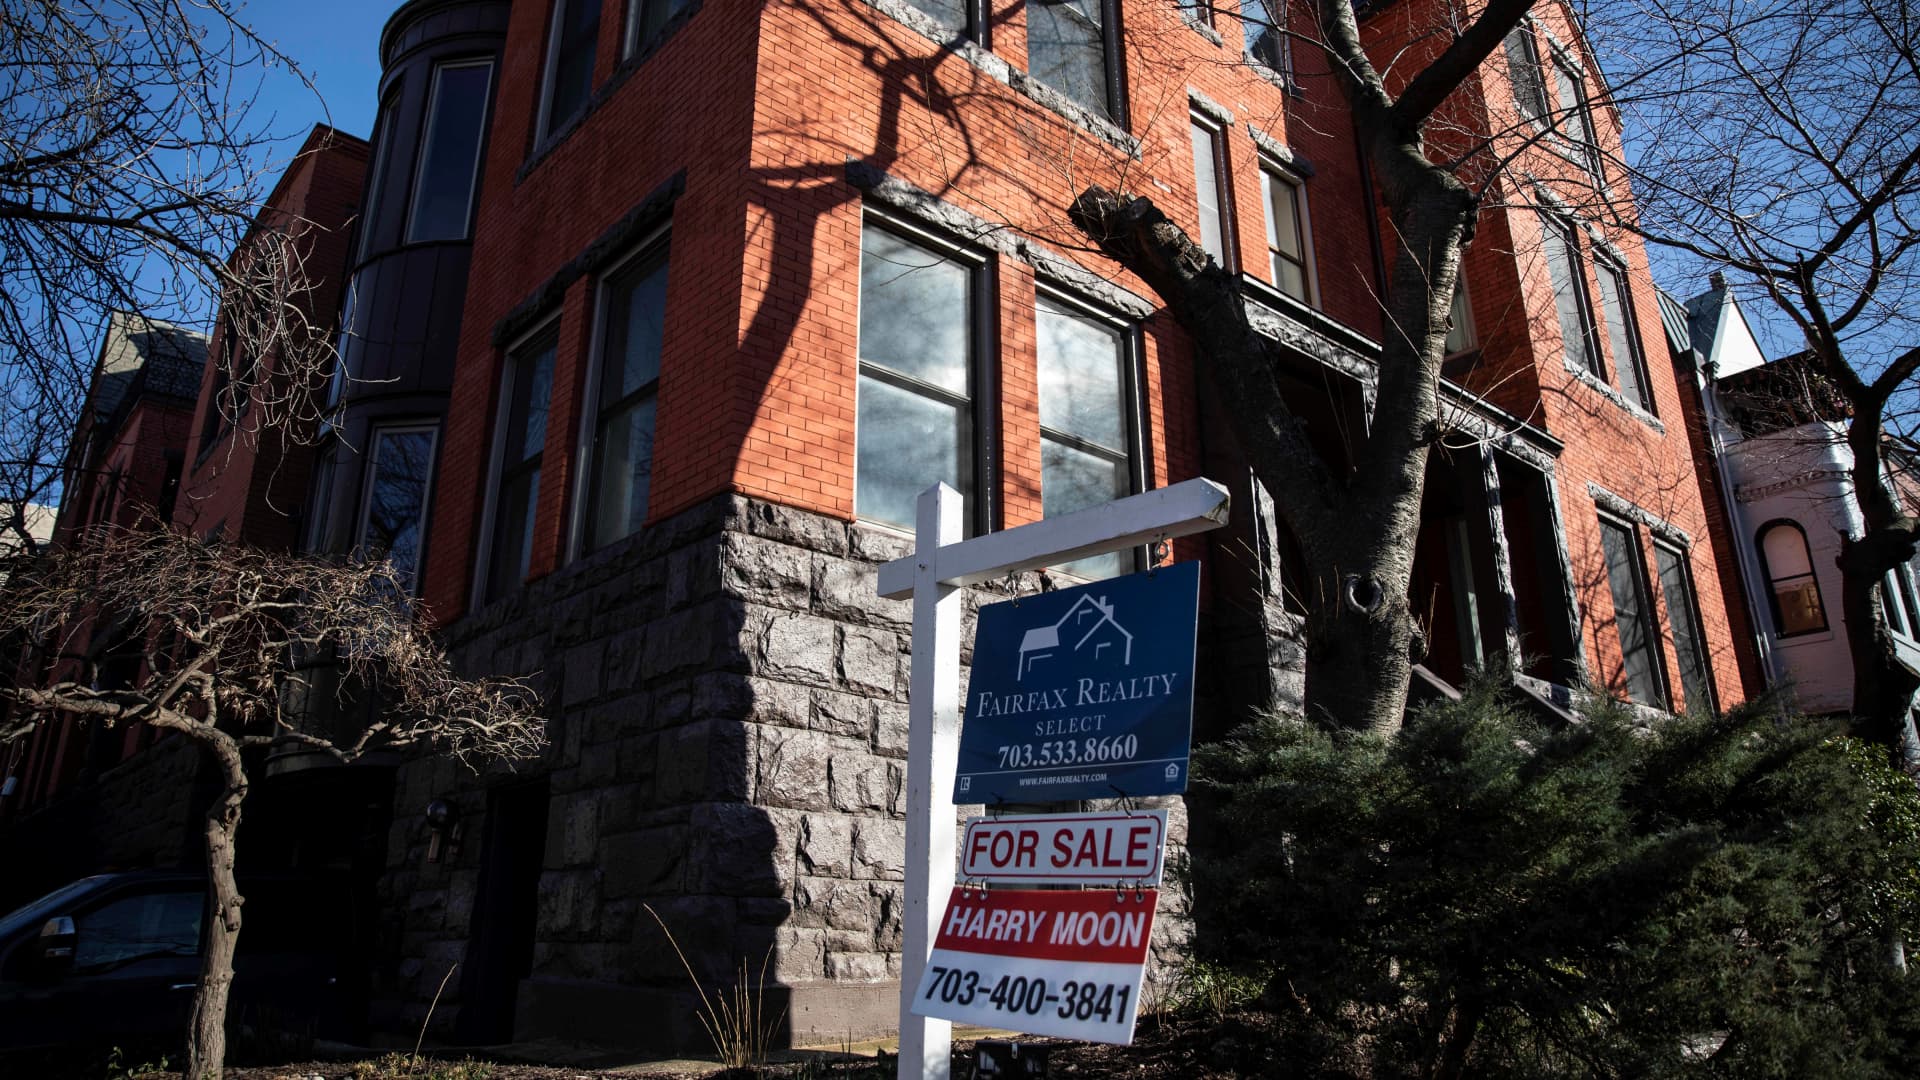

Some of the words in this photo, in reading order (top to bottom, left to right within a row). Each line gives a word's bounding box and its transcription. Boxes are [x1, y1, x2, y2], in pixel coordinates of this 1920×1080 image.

[1035, 714, 1106, 737] SELECT
[998, 733, 1138, 769] 703.533.8660
[1019, 773, 1108, 786] WWW.FAIRFAXREALTY.COM
[969, 830, 1040, 868] FOR
[1050, 827, 1152, 868] SALE
[946, 906, 1047, 943] HARRY
[1050, 911, 1145, 947] MOON
[925, 966, 1131, 1024] 703-400-3841
